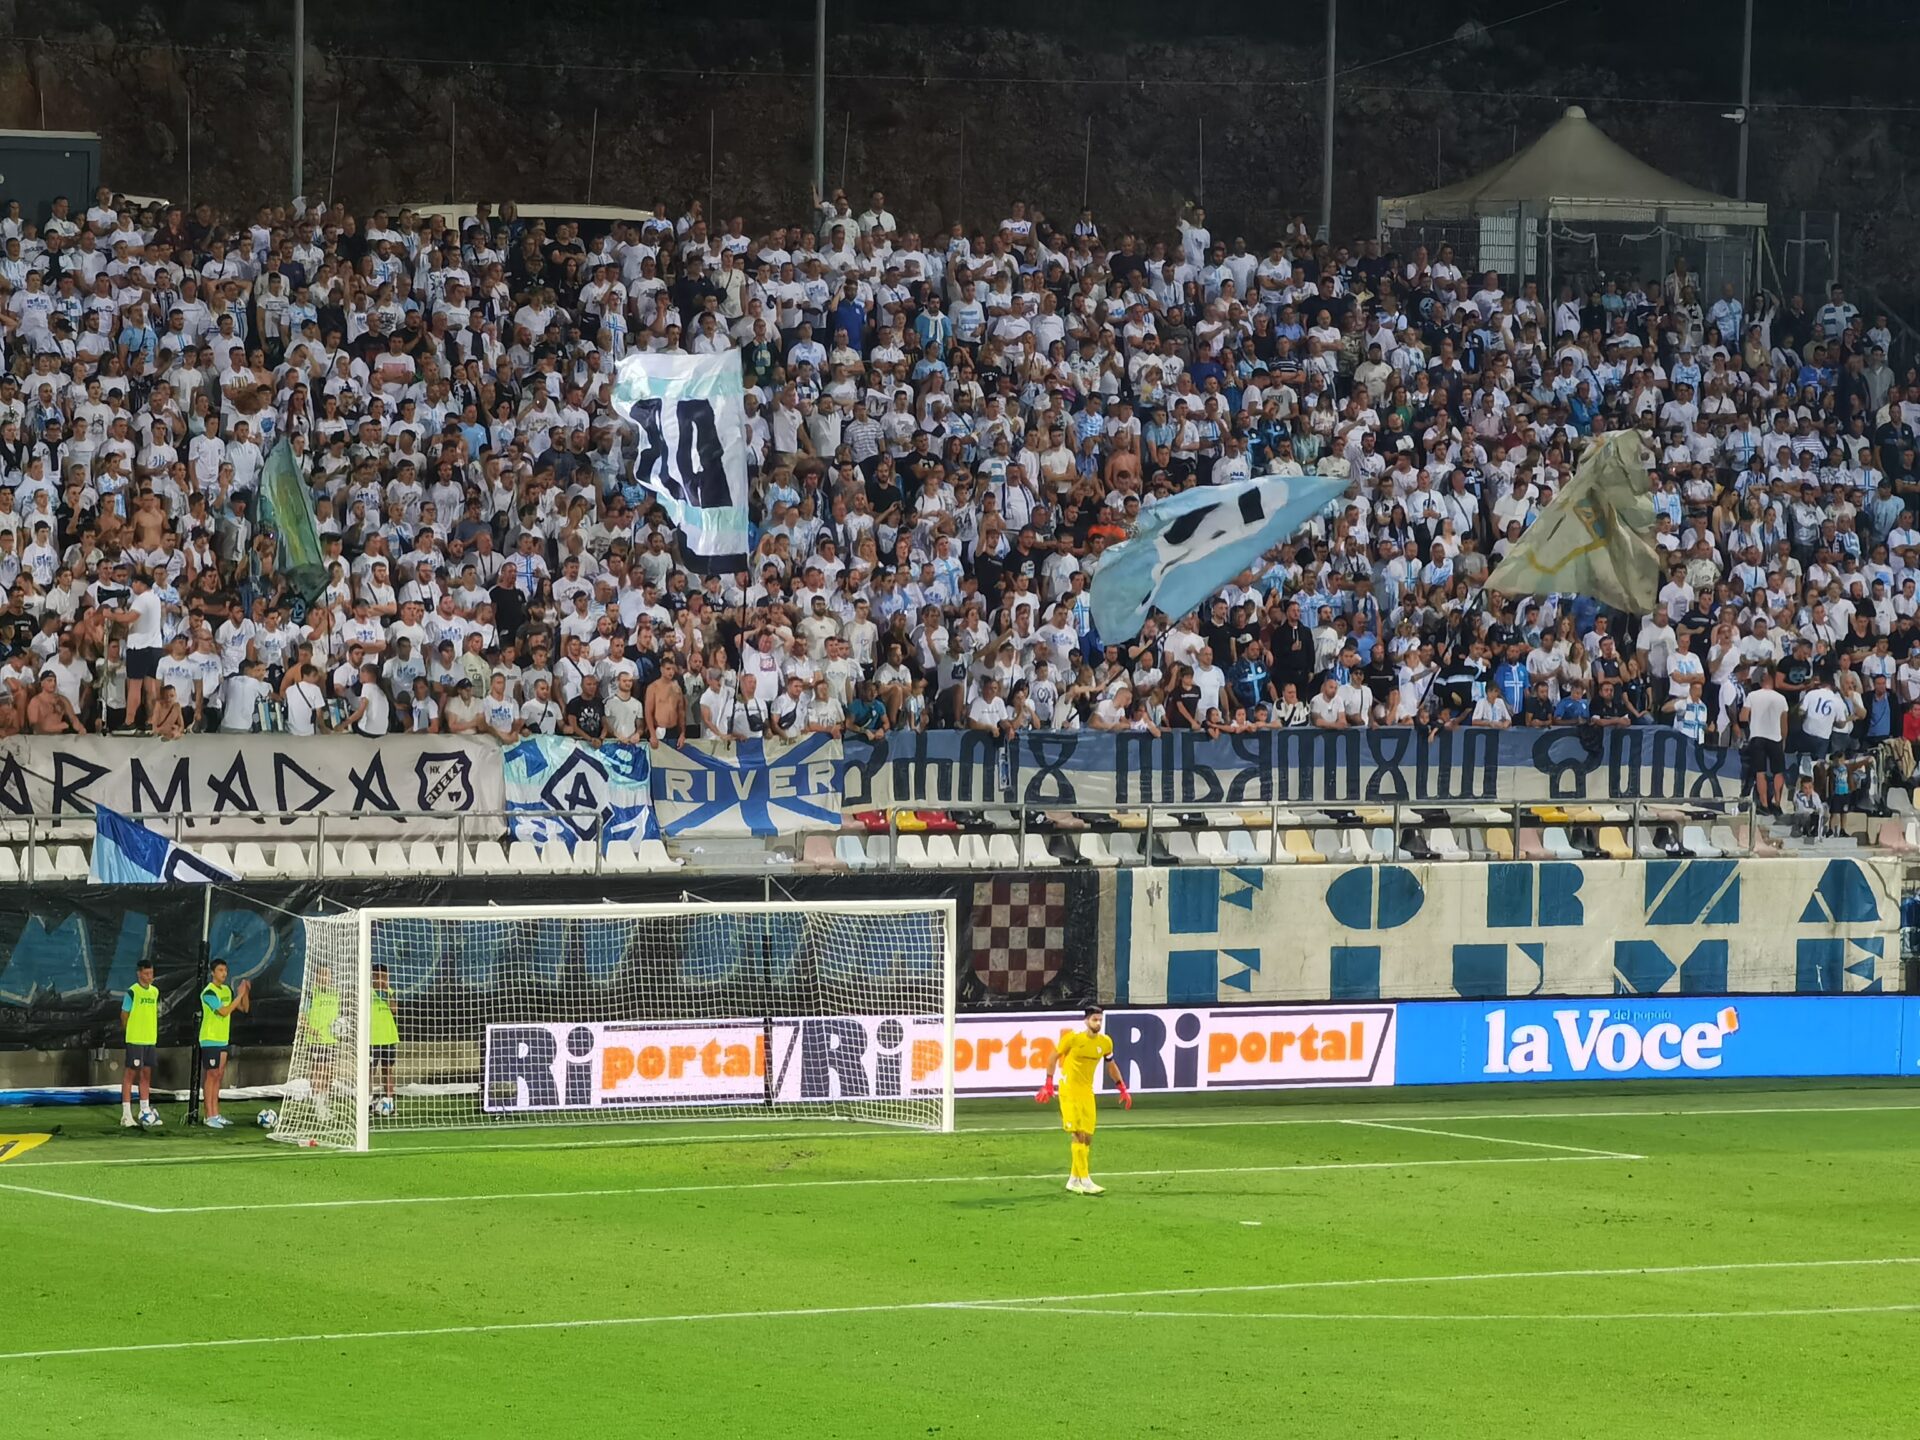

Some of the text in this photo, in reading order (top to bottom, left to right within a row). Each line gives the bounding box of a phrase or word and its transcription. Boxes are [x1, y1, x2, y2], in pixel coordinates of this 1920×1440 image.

[1814, 696, 1832, 716] 16
[426, 762, 464, 805] RIJEKA
[665, 760, 836, 802] RIVER
[1613, 1009, 1630, 1021] del
[488, 1026, 766, 1107] Ri portal
[801, 1018, 904, 1098] Ri
[1102, 1012, 1364, 1090] Ri portal
